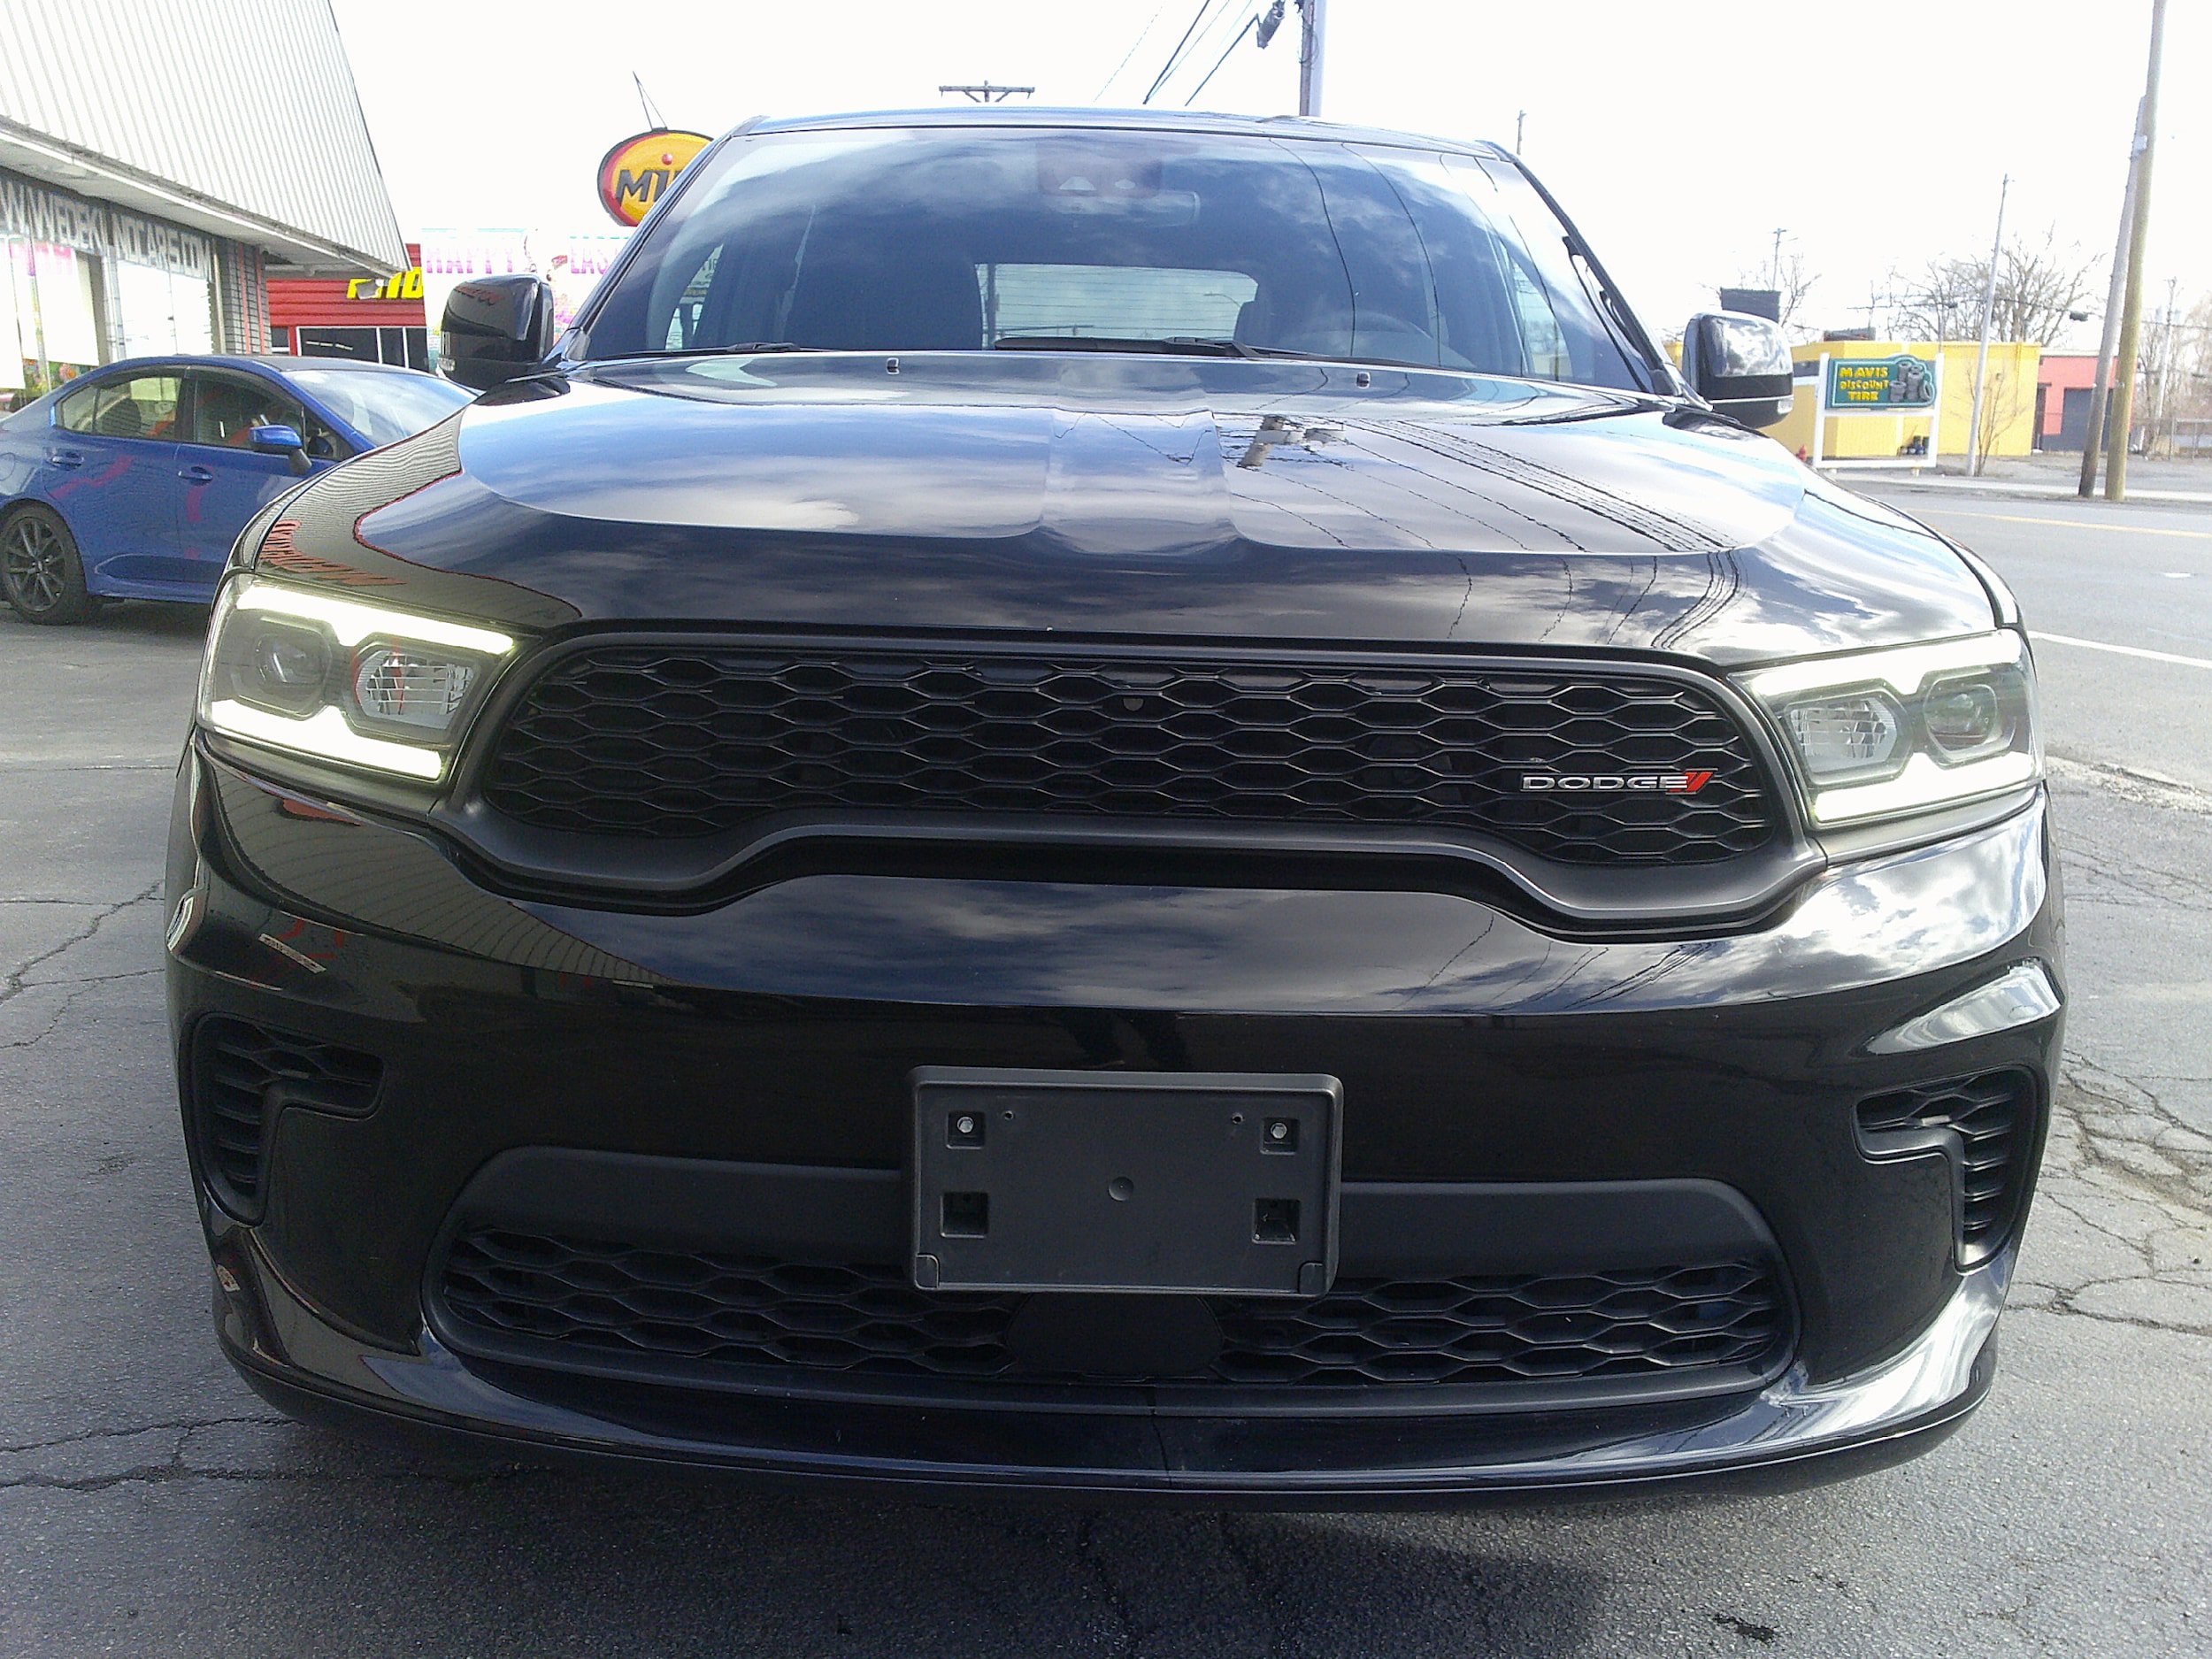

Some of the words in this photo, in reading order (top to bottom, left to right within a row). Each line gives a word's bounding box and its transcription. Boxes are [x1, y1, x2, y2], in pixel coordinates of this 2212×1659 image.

[615, 154, 684, 207] MI
[569, 245, 620, 274] EAS
[1839, 366, 1888, 379] MAVIS
[1847, 391, 1878, 402] TIRE
[1522, 776, 1689, 789] DODGE
